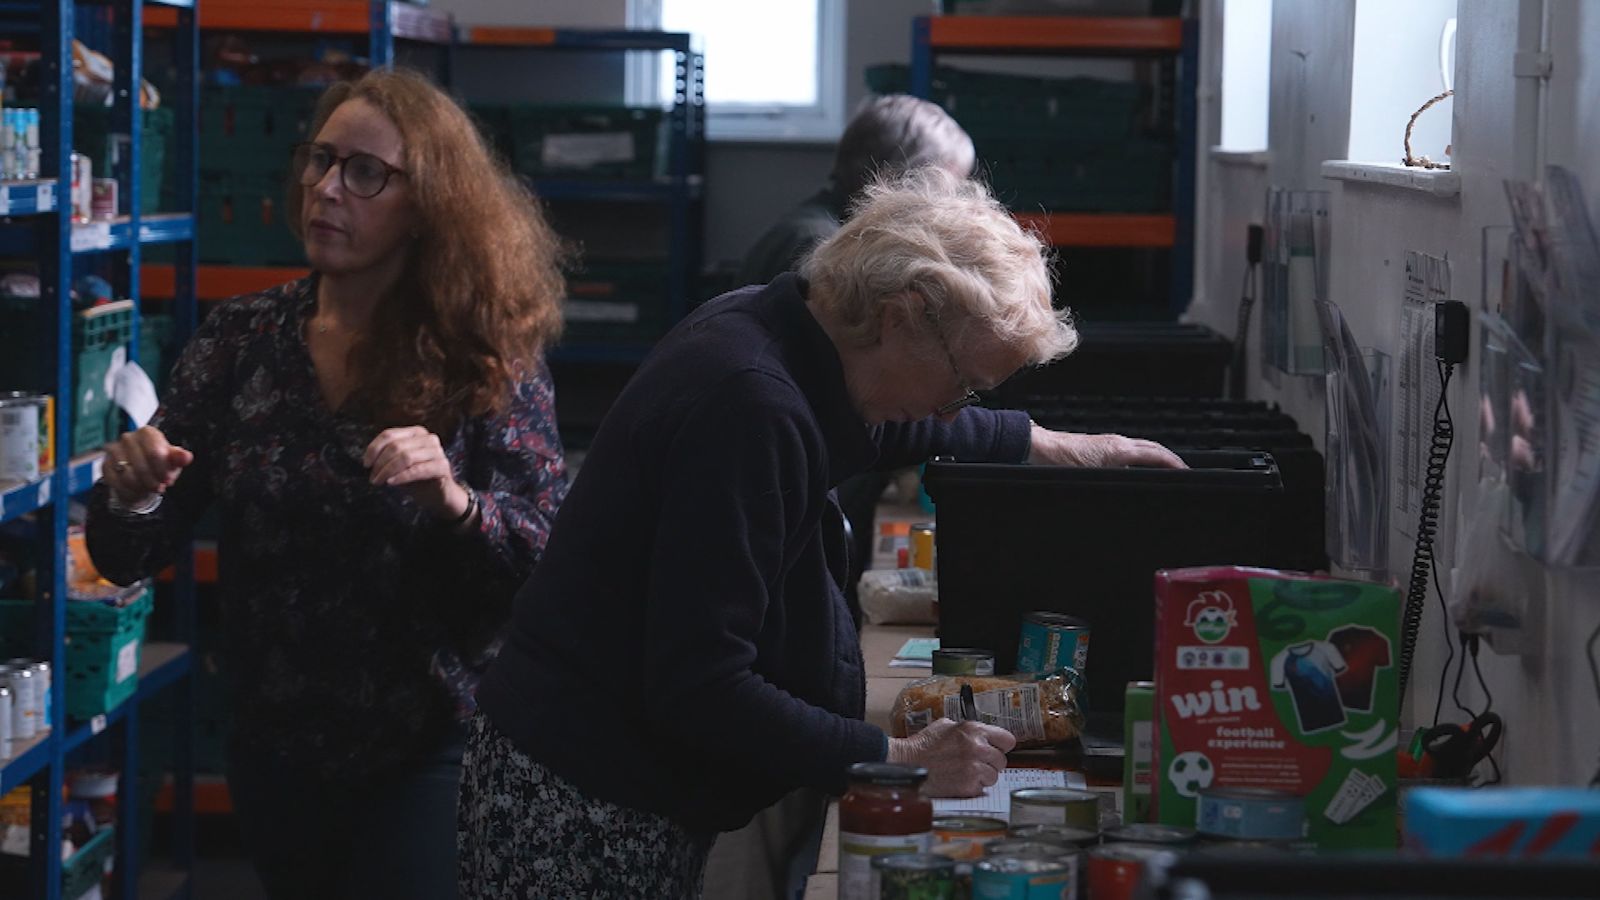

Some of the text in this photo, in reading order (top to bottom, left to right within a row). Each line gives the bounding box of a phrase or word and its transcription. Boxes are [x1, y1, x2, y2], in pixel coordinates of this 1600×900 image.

[1171, 679, 1262, 718] win
[1216, 726, 1275, 738] football
[1207, 738, 1286, 750] experience
